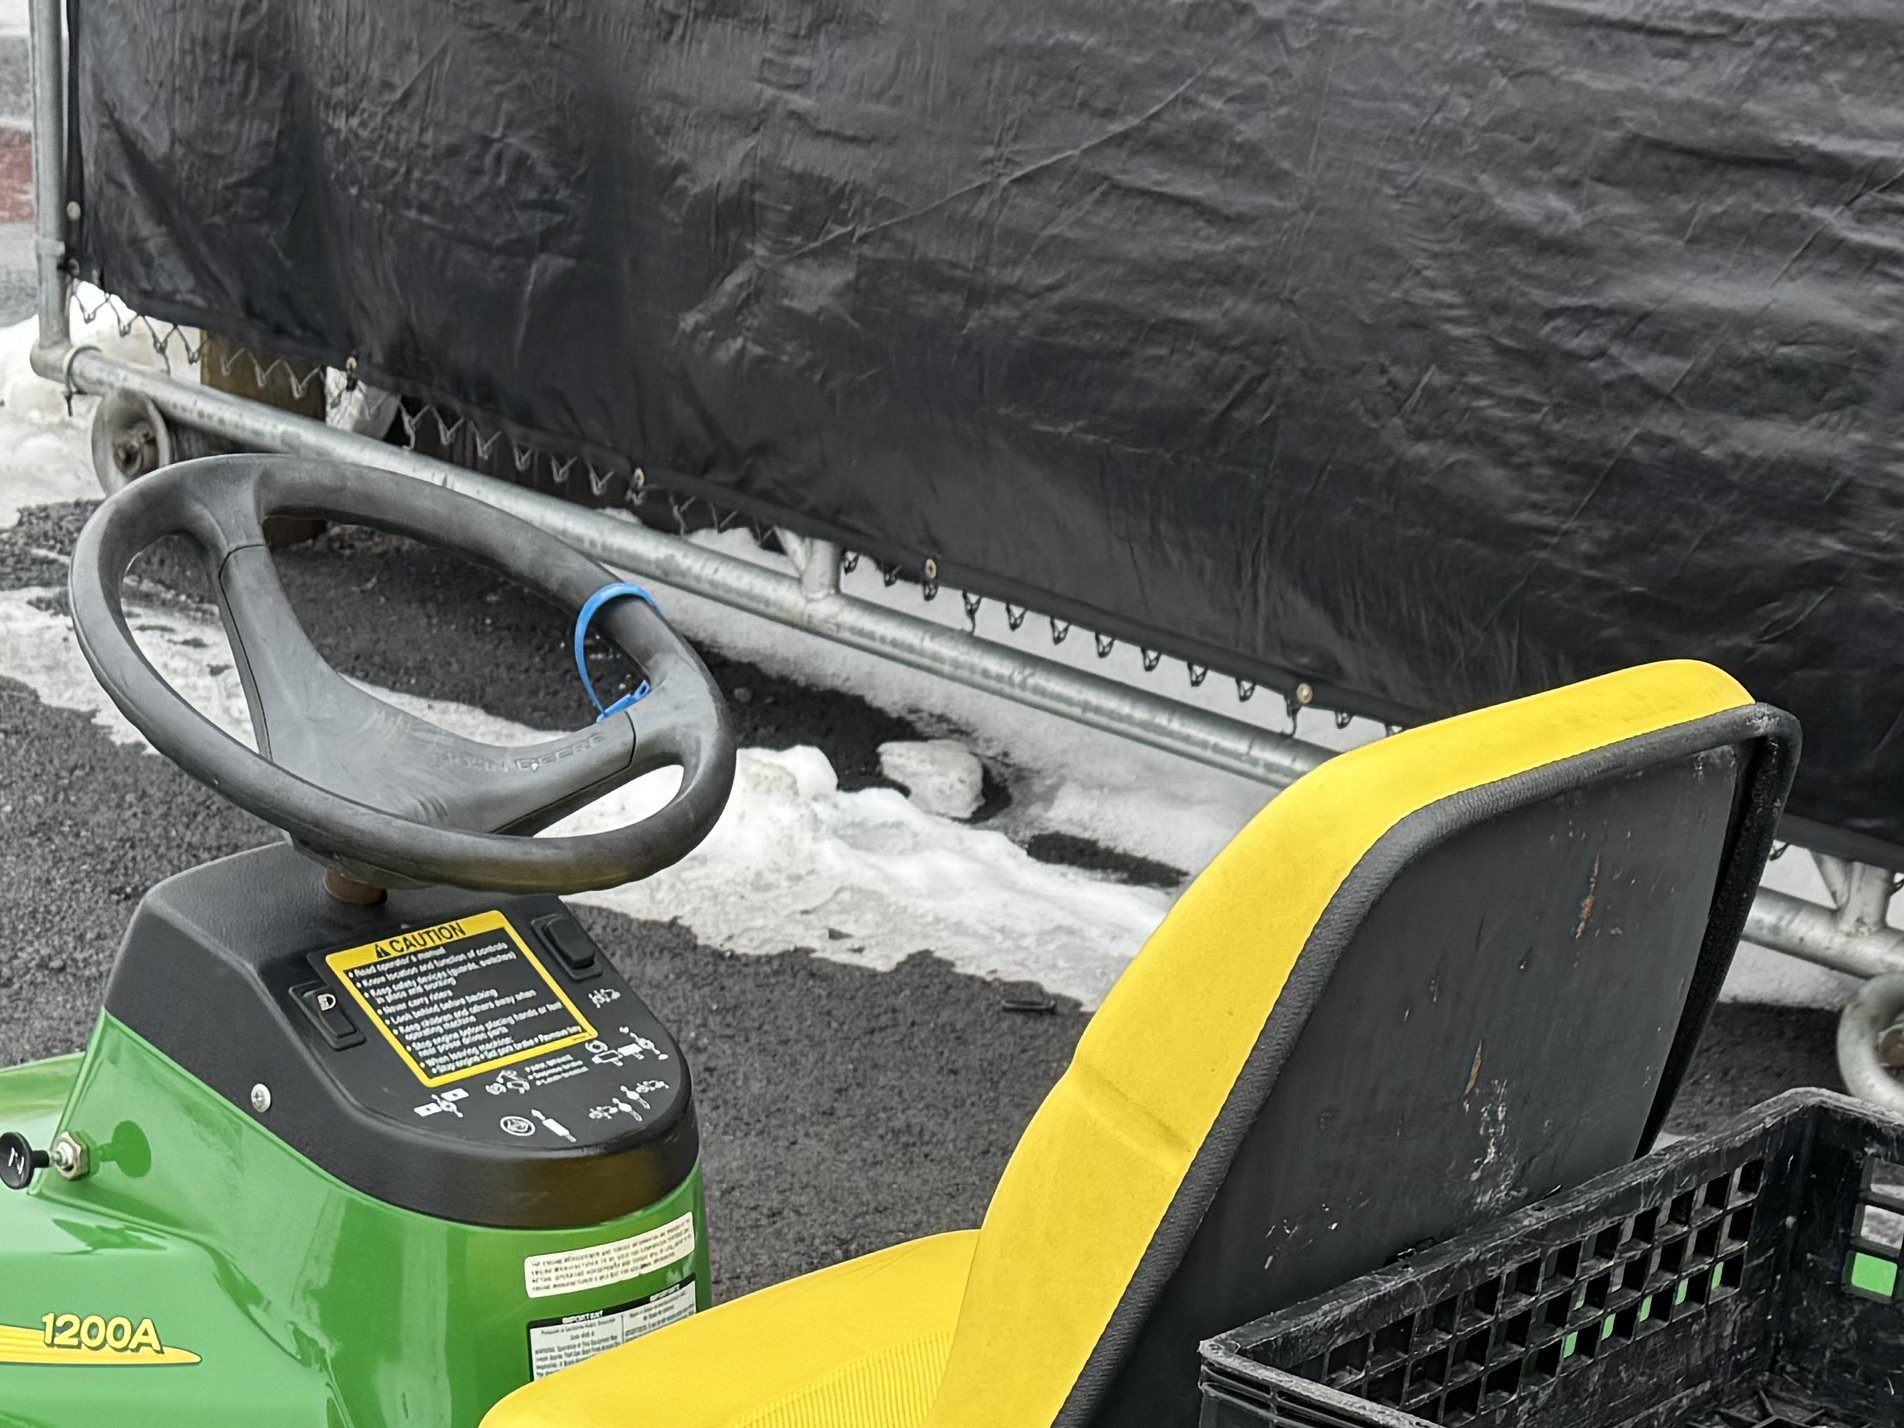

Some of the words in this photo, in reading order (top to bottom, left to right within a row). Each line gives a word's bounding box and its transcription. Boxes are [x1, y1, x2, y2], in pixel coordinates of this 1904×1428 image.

[388, 921, 467, 954] CAUTION
[385, 967, 418, 980] location
[418, 961, 435, 973] and
[433, 953, 467, 968] function
[476, 942, 508, 956] controls
[41, 1312, 165, 1354] 1200A
